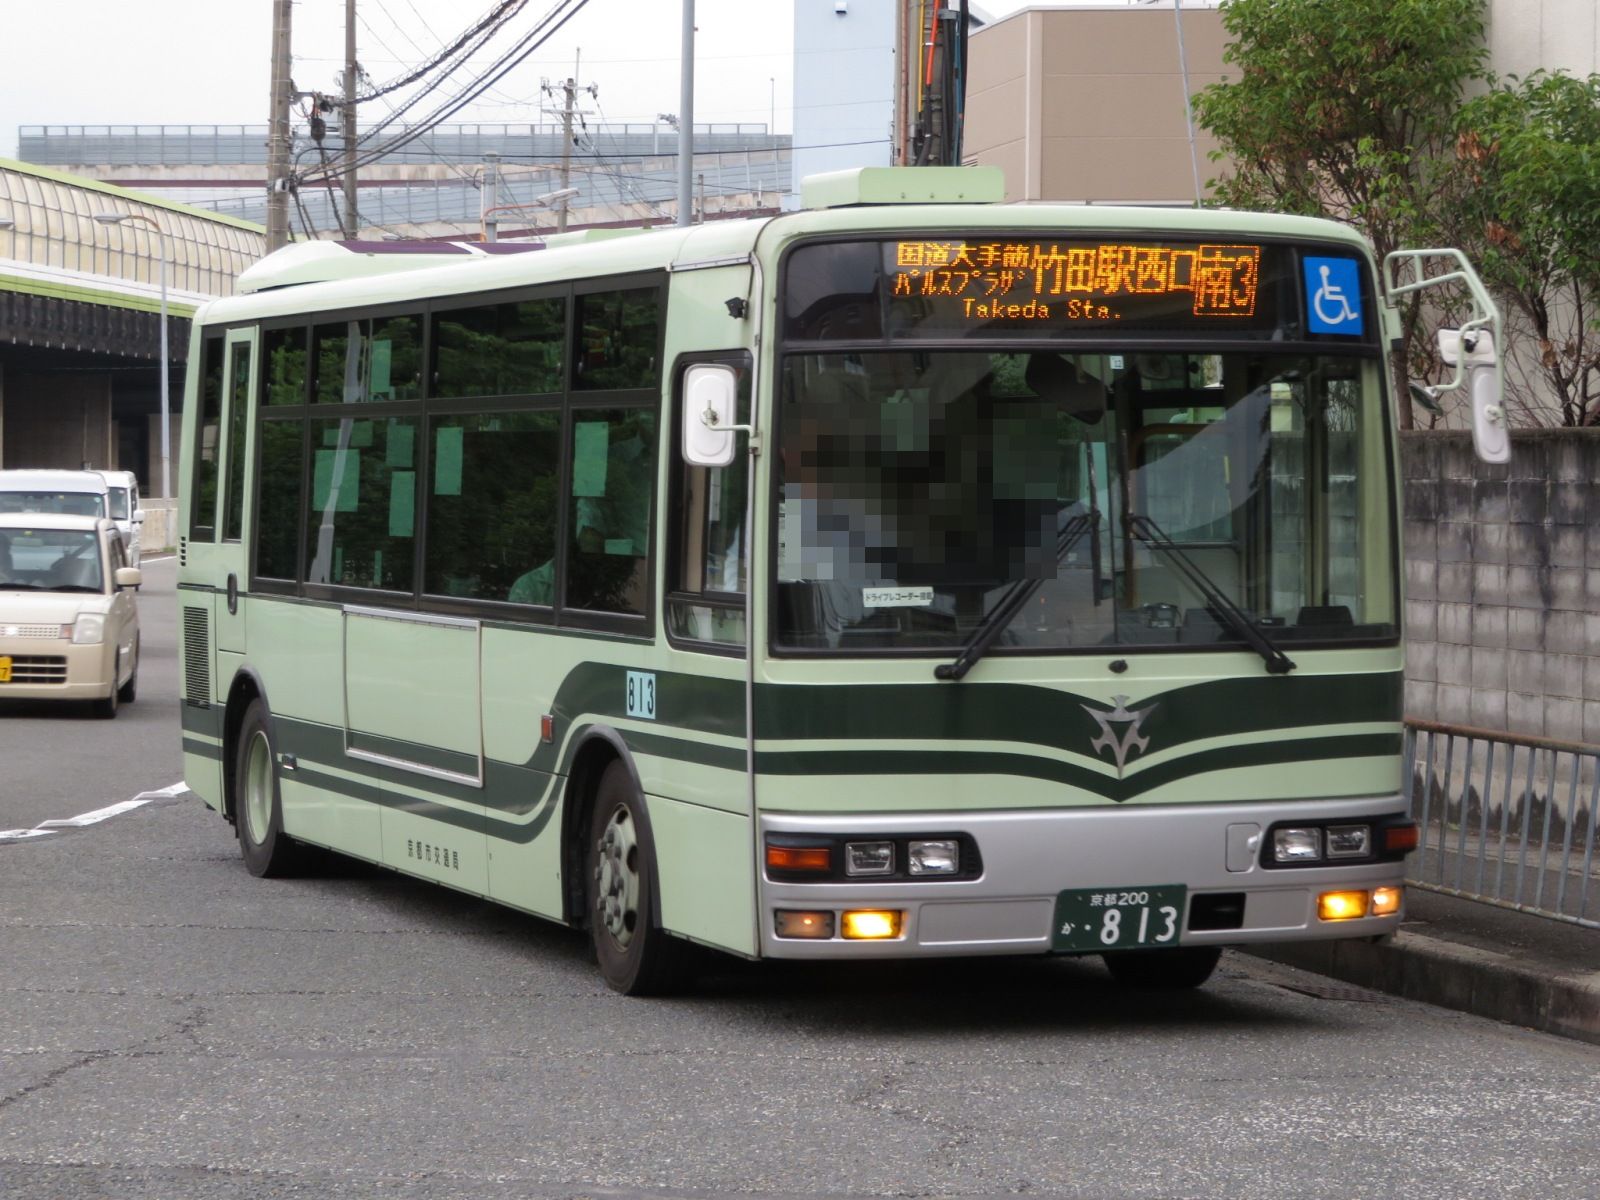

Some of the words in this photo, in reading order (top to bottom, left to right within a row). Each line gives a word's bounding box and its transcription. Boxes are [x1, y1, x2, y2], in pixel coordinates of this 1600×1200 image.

[897, 242, 1030, 268] 国道大手筋
[1029, 244, 1198, 294] 竹田駅西口
[962, 298, 1050, 319] Takeda
[1067, 299, 1121, 319] Sta.
[628, 676, 655, 715] 813
